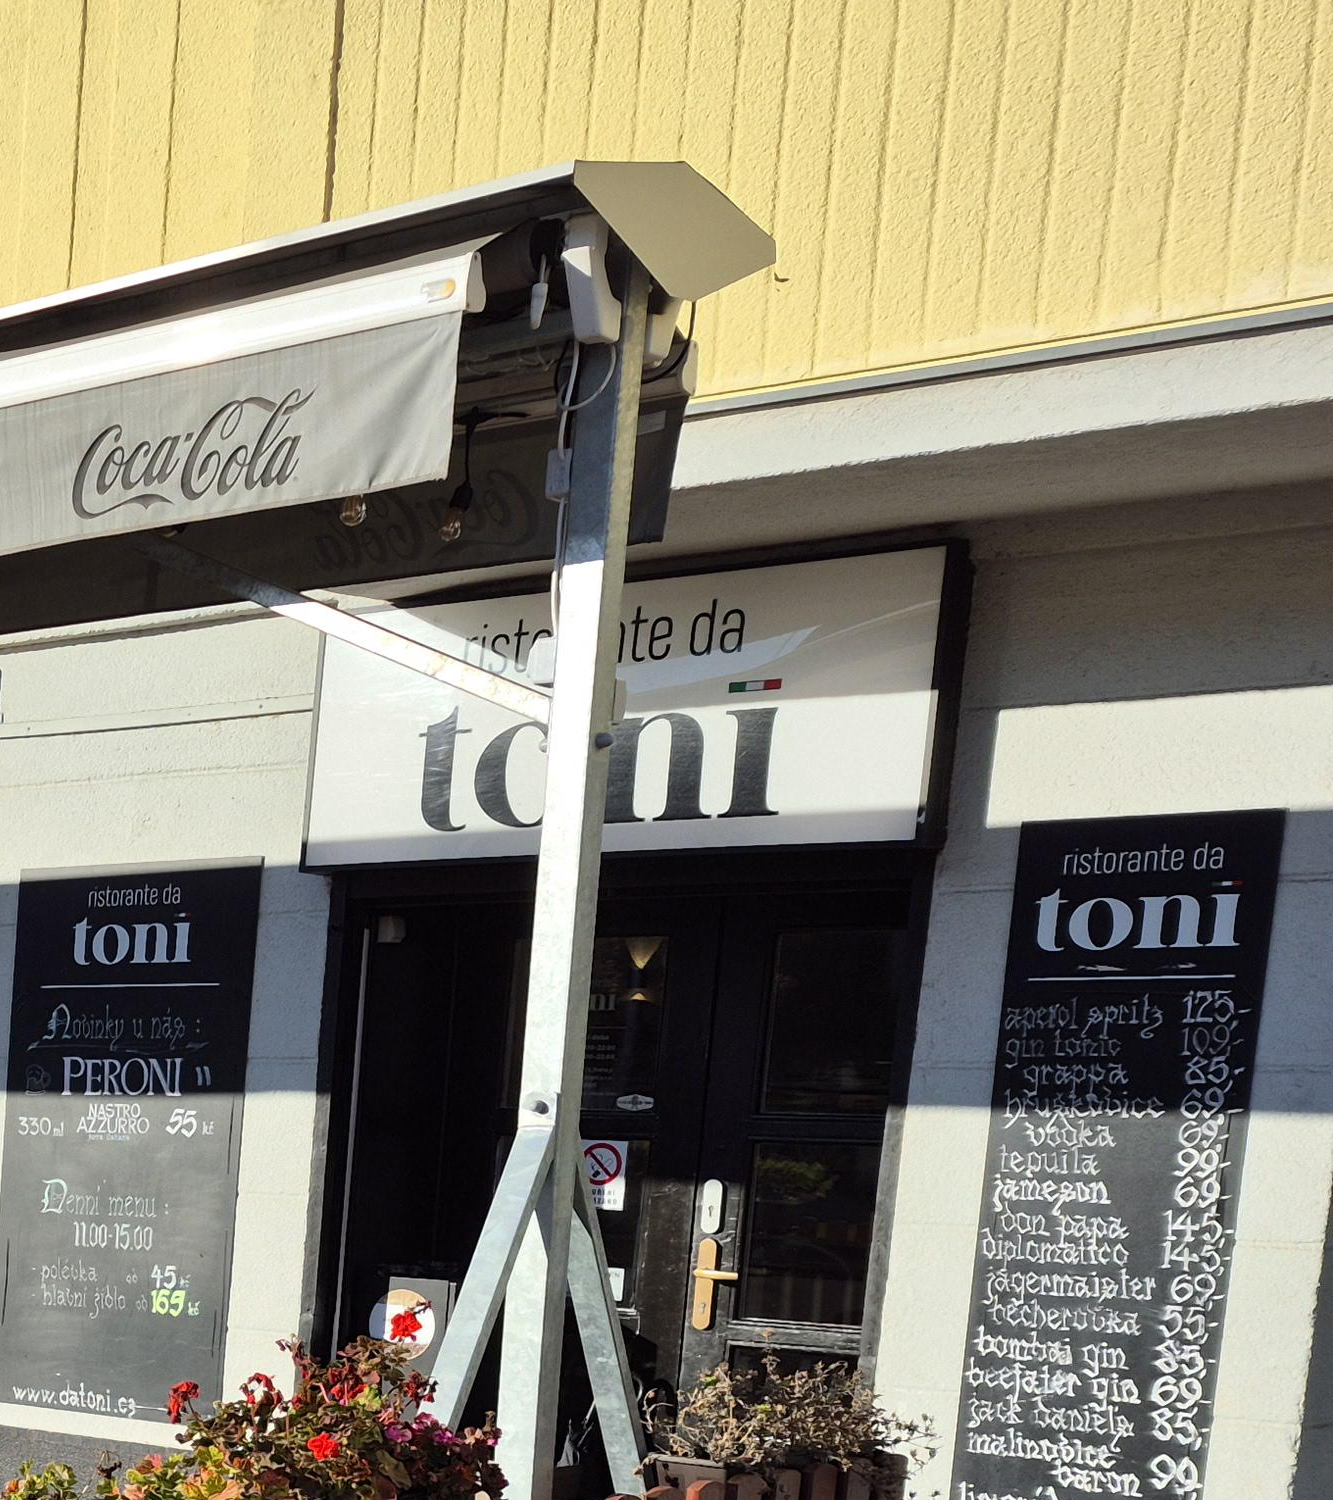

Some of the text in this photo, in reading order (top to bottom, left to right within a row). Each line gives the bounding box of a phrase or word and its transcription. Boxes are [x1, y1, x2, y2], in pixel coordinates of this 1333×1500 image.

[71, 382, 319, 520] Coca-Cola
[464, 600, 746, 676] ristte da
[1063, 842, 1225, 875] ristorante da
[88, 883, 181, 908] ristorante da
[1035, 881, 1242, 951] toni
[72, 912, 192, 966] toni
[132, 1016, 144, 1040] u
[1004, 1038, 1044, 1069] gin
[1054, 1029, 1123, 1057] tonic
[60, 1056, 184, 1097] PERONI
[1023, 1061, 1129, 1099] grappa
[76, 1116, 150, 1134] AZZURRO
[165, 1108, 198, 1139] 55
[88, 1103, 141, 1119] NASTRO
[1000, 1144, 1101, 1178] tequila
[40, 1178, 101, 1216] Denní
[108, 1195, 157, 1218] menu
[992, 1174, 1112, 1216] jameson
[74, 1221, 153, 1251] 11.00-15.00
[1000, 1202, 1050, 1237] don
[1055, 1214, 1130, 1250] papa
[981, 1227, 1130, 1271] diplomatico
[150, 1264, 177, 1290] 45
[151, 1288, 186, 1317] 169
[987, 1294, 1142, 1336] becherovka
[1081, 1342, 1130, 1377] gin
[967, 1392, 1025, 1429] jack
[1083, 1374, 1142, 1412] gin
[1048, 1459, 1144, 1498] baron
